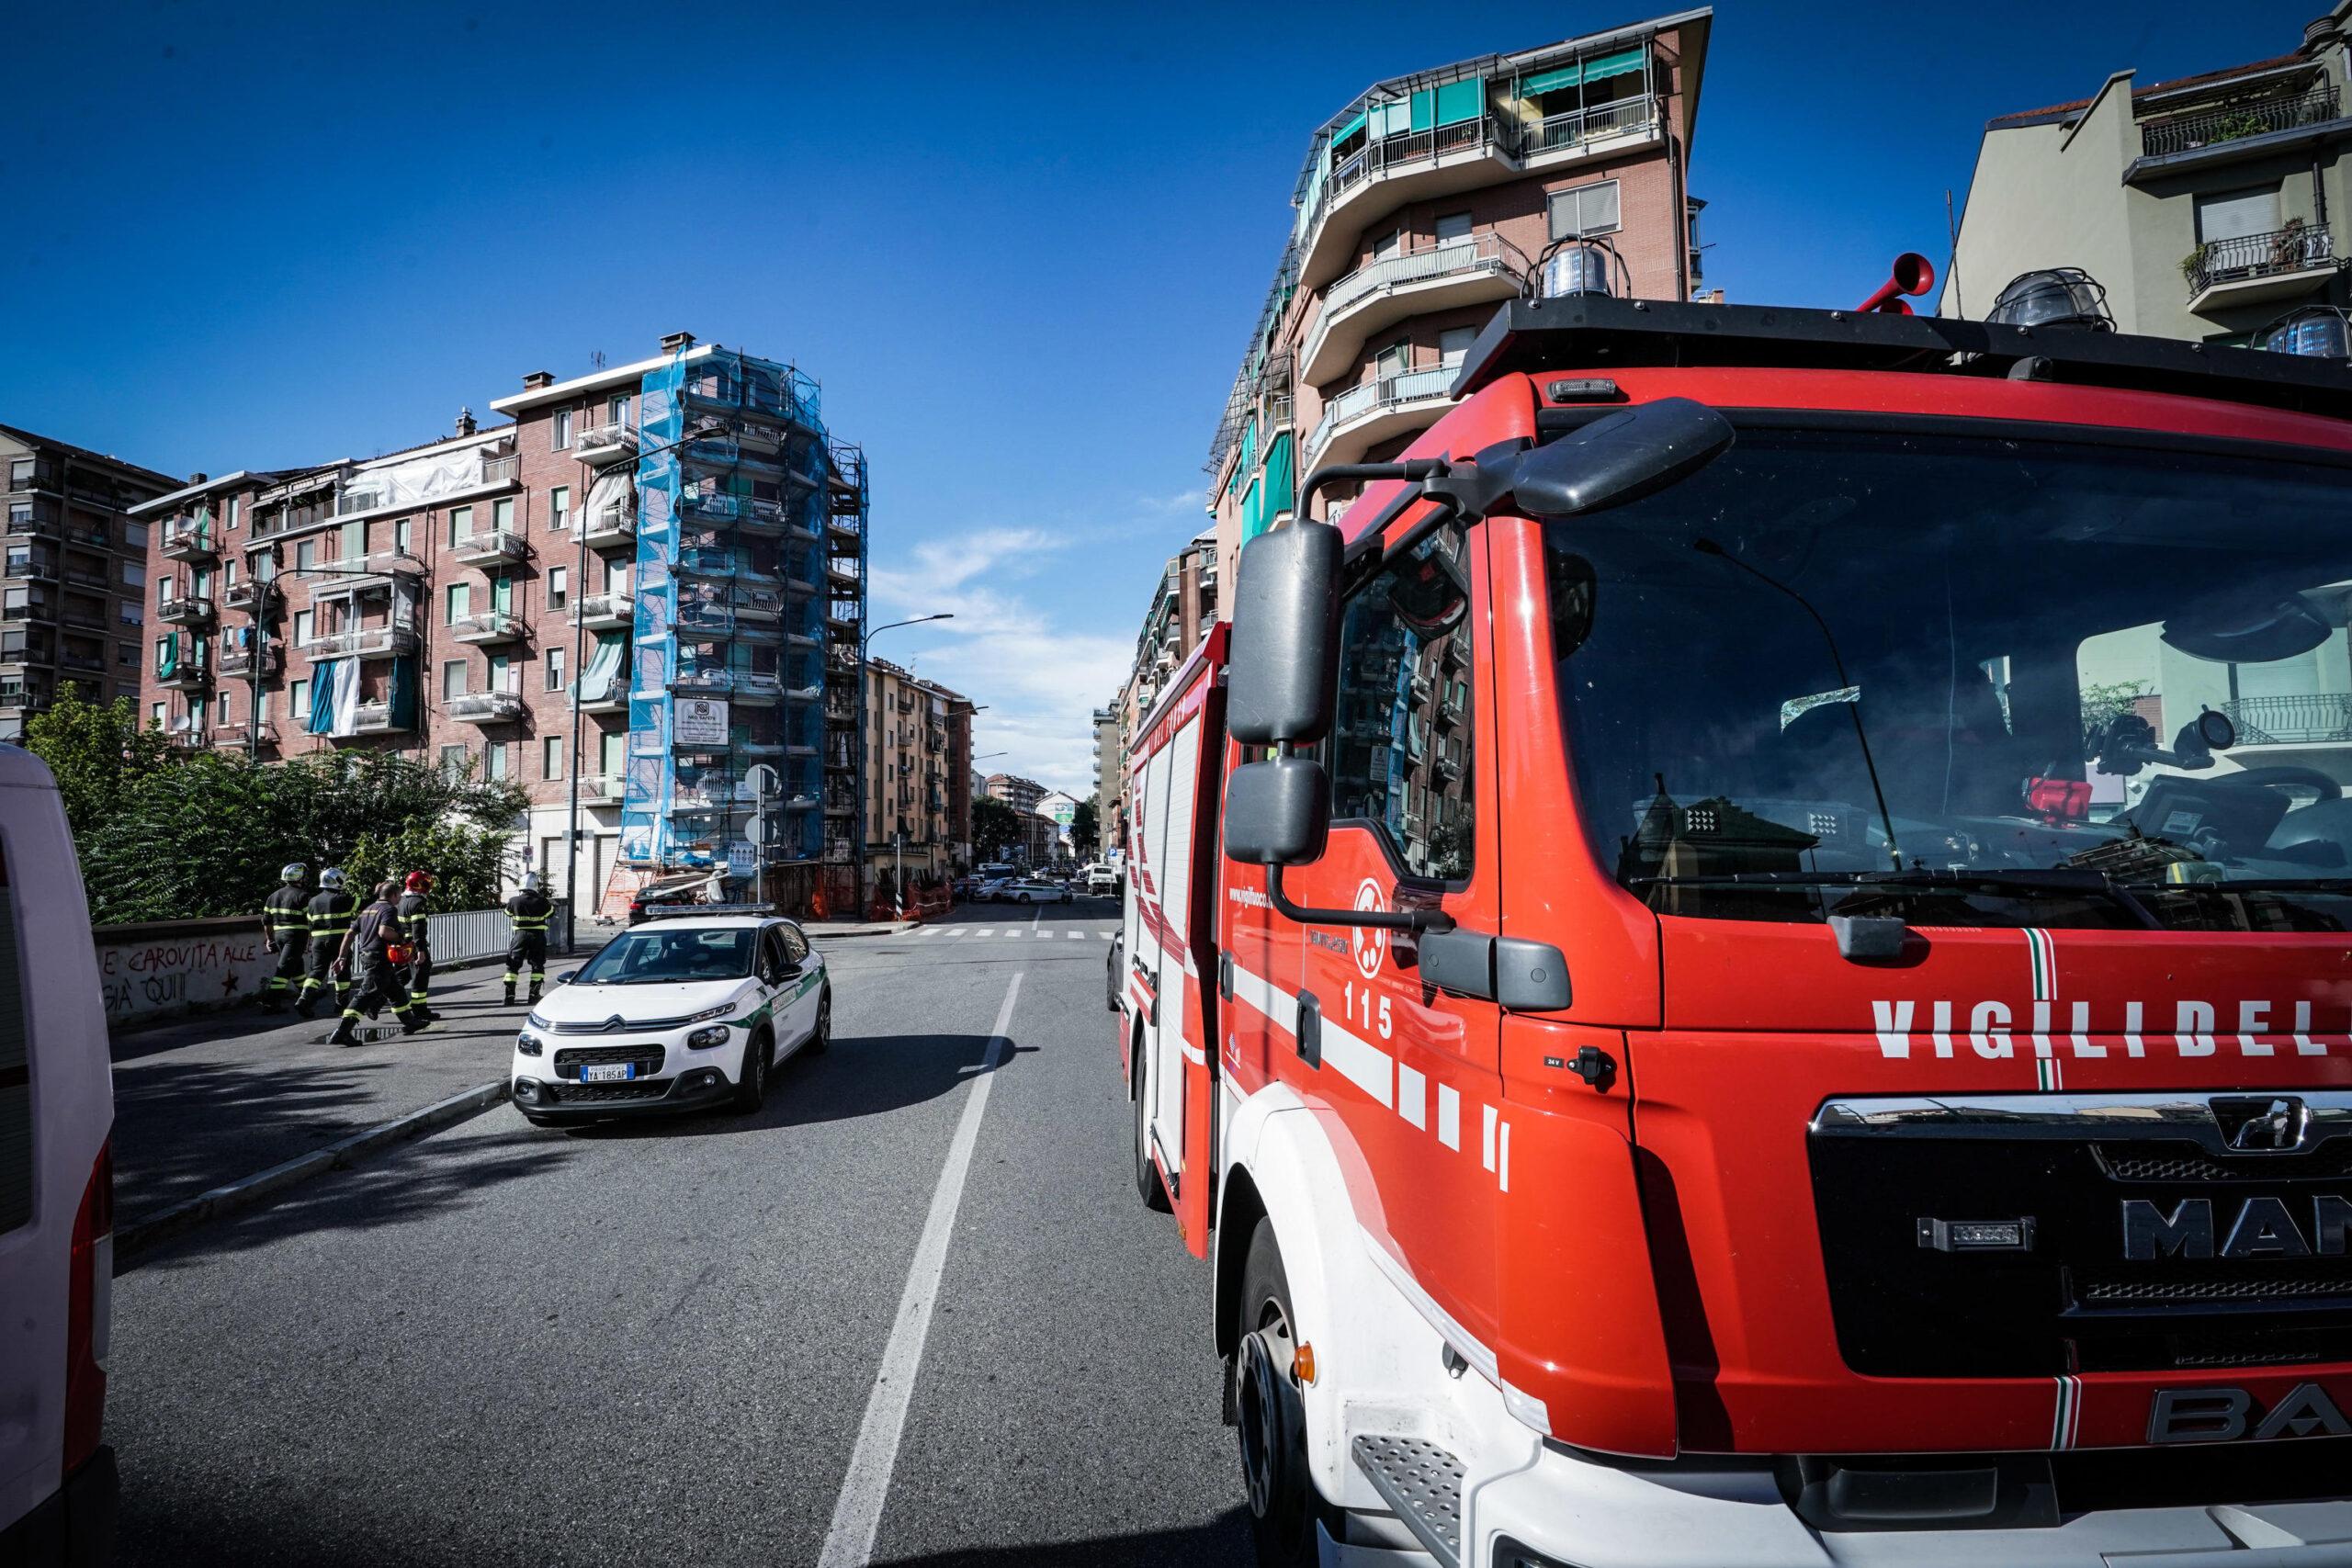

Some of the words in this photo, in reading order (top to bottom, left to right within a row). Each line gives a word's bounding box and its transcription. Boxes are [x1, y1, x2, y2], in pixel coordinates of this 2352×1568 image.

[223, 944, 257, 963] ALLE
[1344, 980, 1393, 1040] 115
[1871, 1000, 2146, 1059] VIGILI
[2174, 999, 2328, 1057] DEL
[589, 1072, 598, 1080] YA
